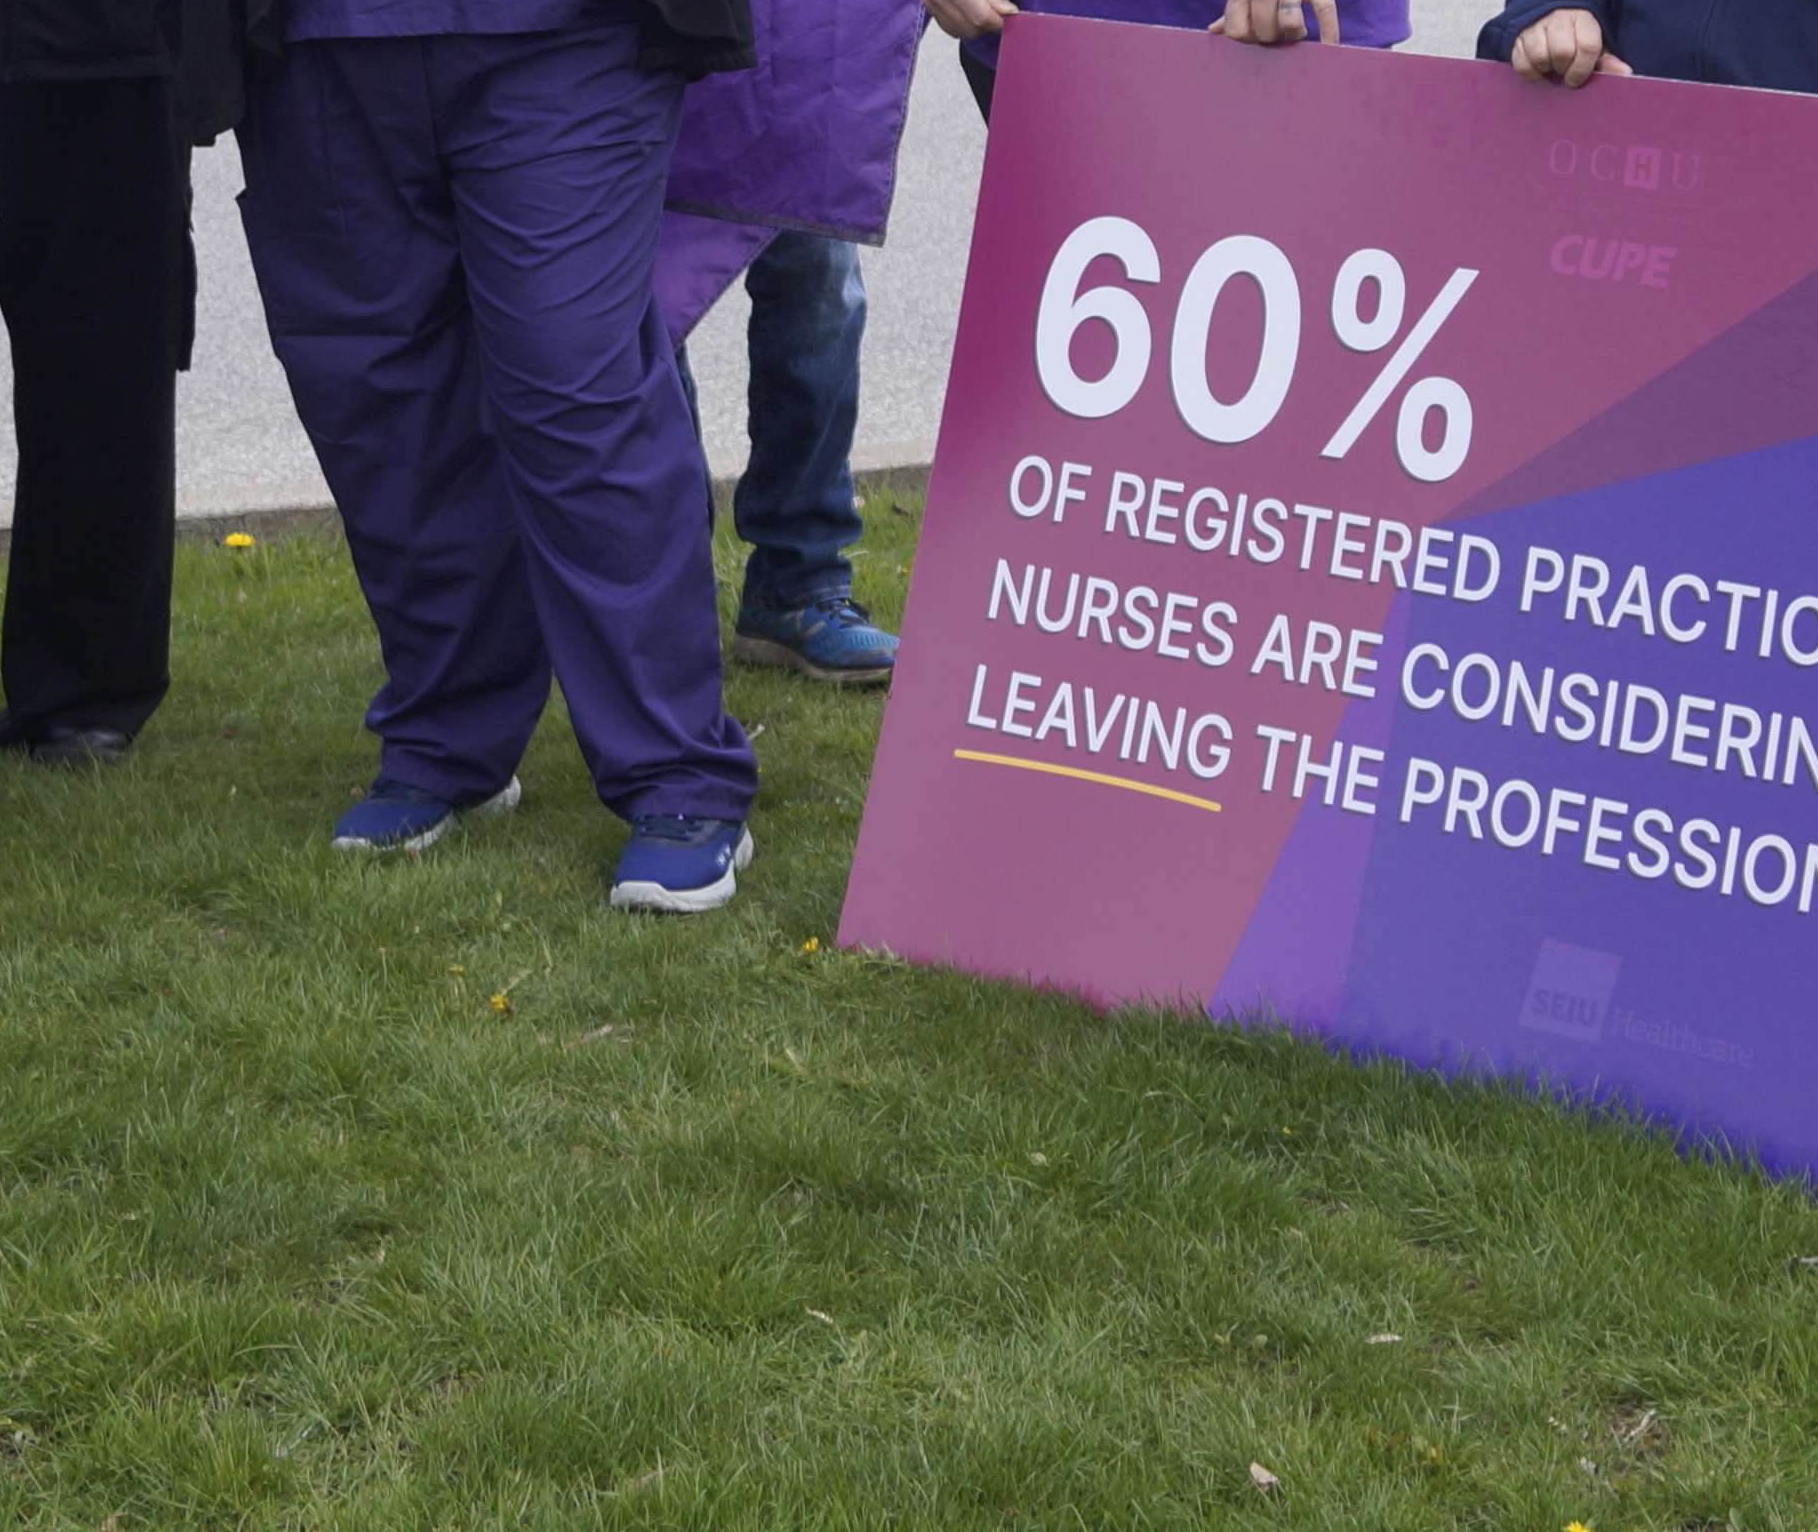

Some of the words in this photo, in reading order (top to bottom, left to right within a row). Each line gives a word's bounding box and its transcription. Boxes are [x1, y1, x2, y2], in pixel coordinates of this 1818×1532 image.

[1549, 234, 1679, 288] CUPE
[1034, 214, 1481, 483] 60%
[1008, 454, 1094, 524] OF
[1103, 469, 1502, 603] REGISTERED
[986, 557, 1239, 667] NURSES
[1249, 612, 1385, 699] ARE
[966, 662, 1234, 780] LEAVING
[1255, 722, 1386, 816] THE
[1533, 988, 1599, 1027] SEIU
[1610, 1006, 1755, 1069] Healthcare
